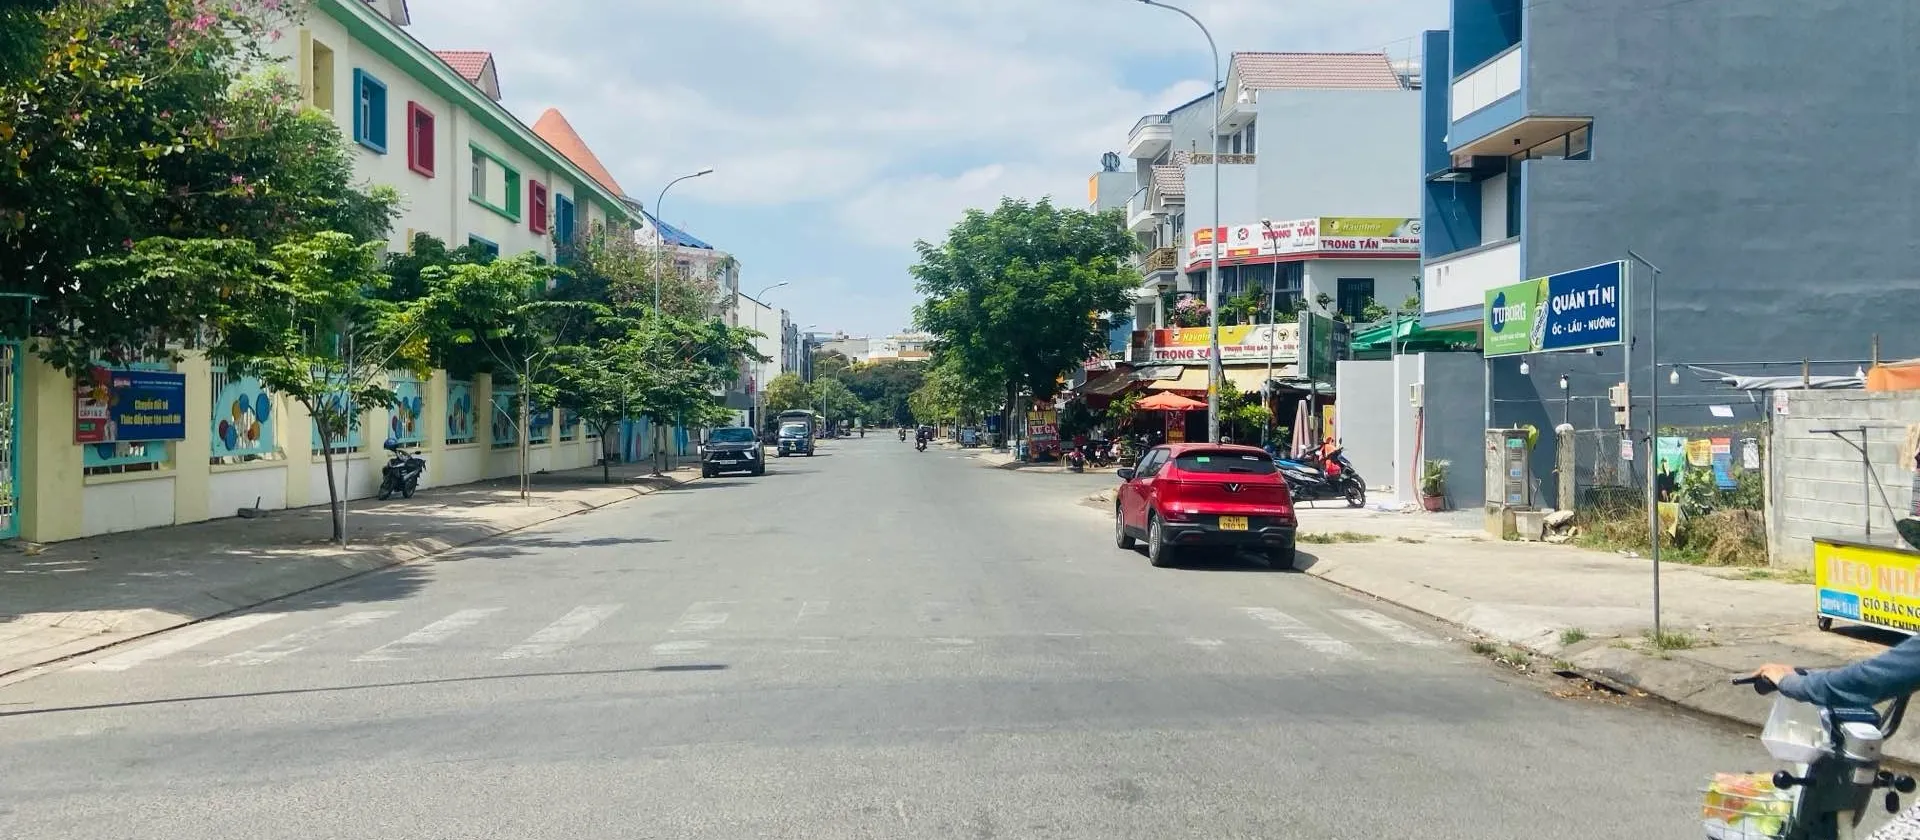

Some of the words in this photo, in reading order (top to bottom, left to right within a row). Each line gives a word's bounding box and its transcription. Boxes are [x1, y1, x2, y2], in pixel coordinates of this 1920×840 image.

[1552, 288, 1585, 315] QUÁN
[1588, 284, 1600, 306] TÍ
[1602, 286, 1615, 308] NỊ
[1492, 303, 1526, 325] TUBORG
[1552, 320, 1562, 335] ỐC
